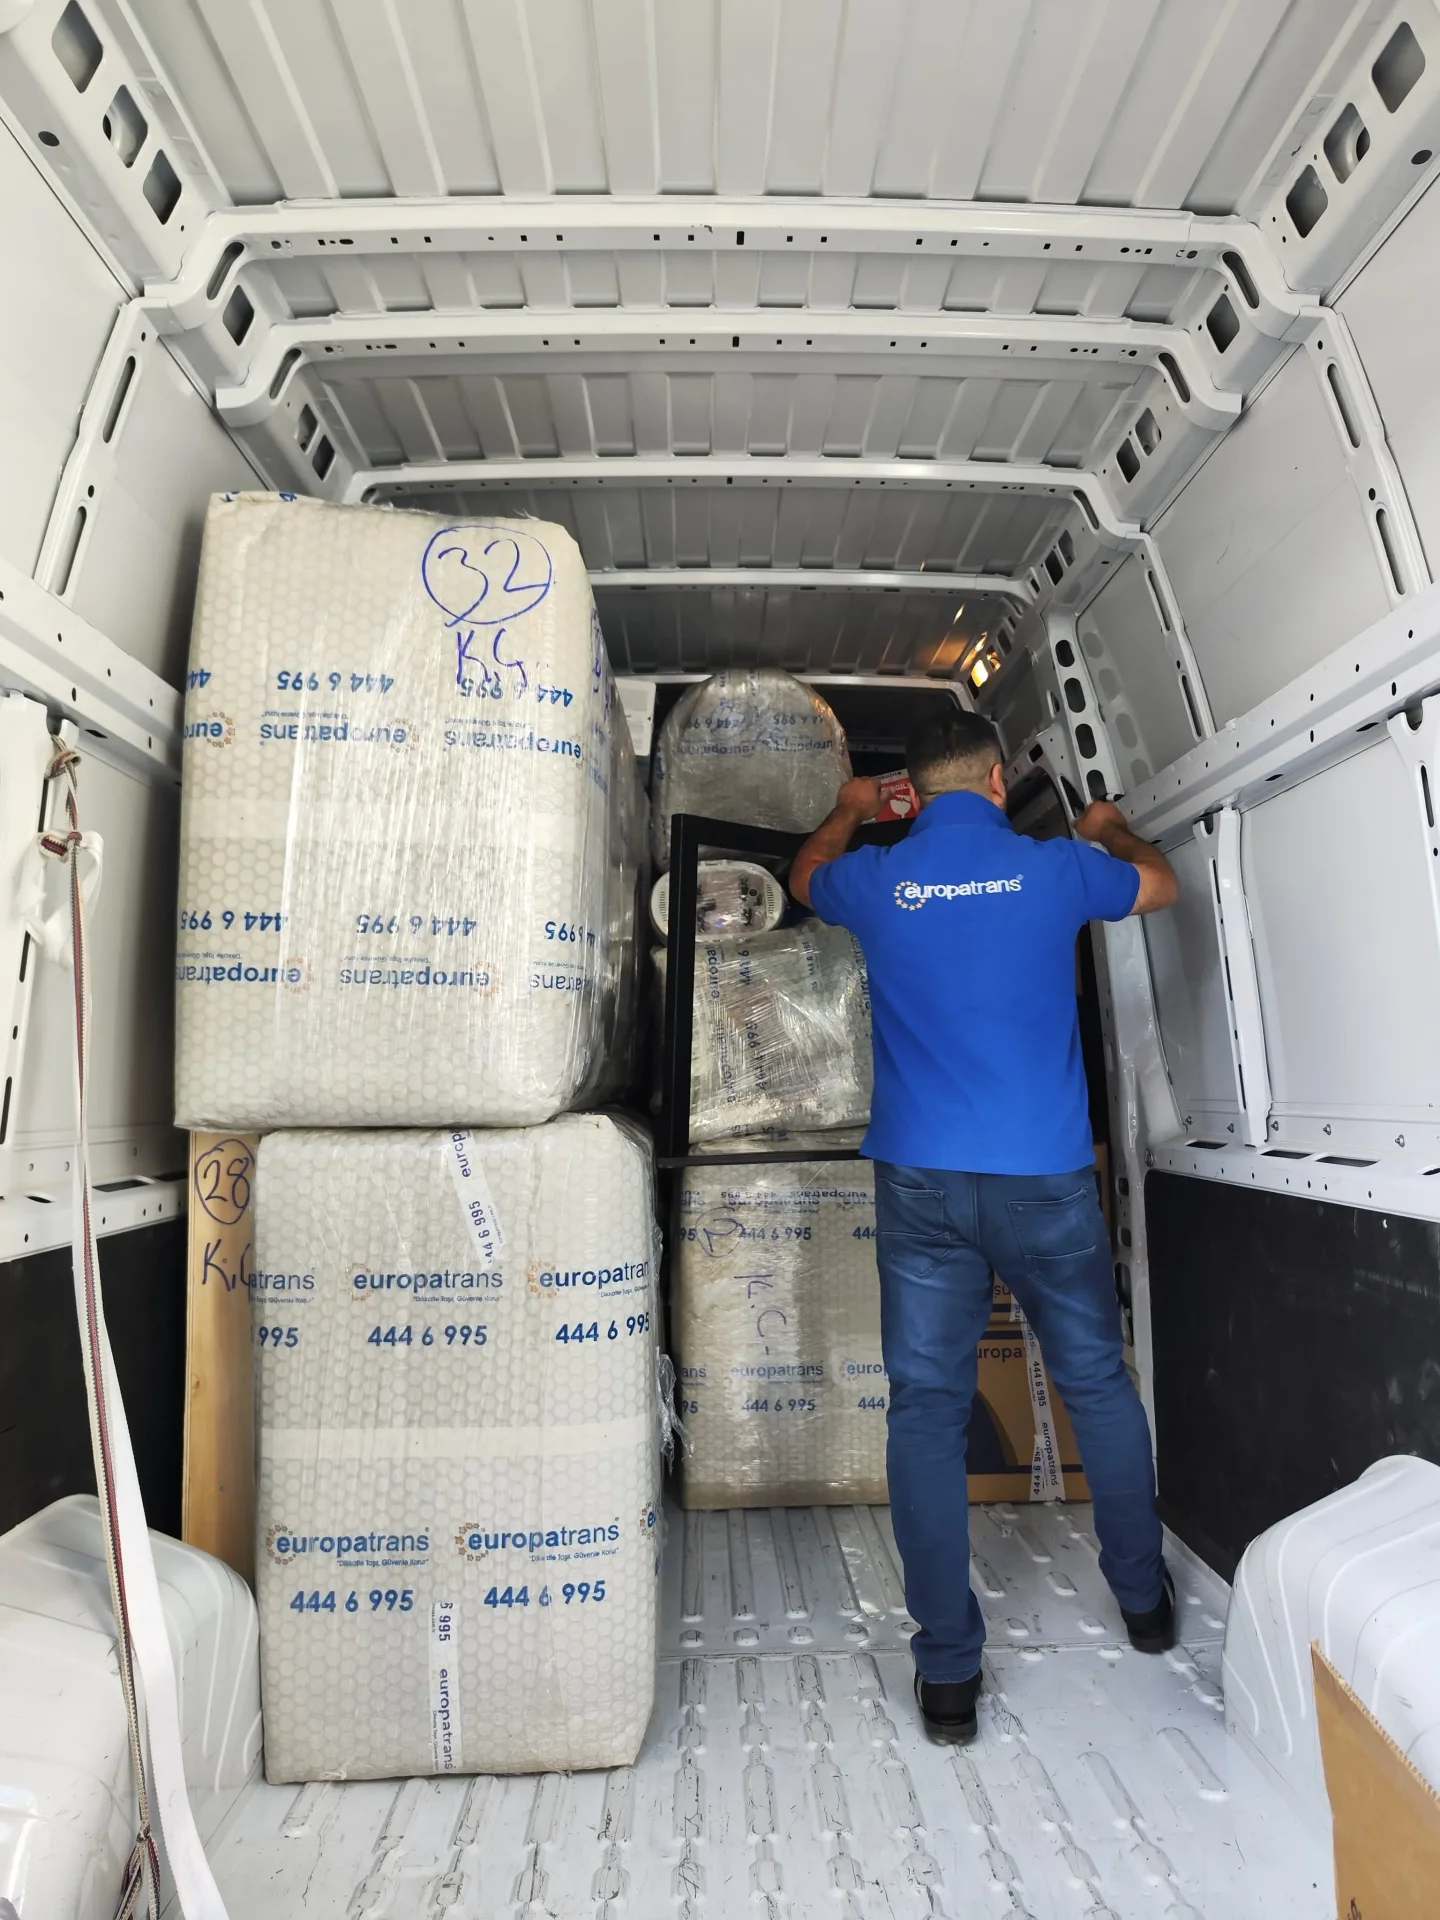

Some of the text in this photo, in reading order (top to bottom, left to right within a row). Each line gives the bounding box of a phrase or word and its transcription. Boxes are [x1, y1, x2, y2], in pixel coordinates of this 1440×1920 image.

[438, 538, 549, 627] 32
[277, 671, 394, 694] 444 6 995
[460, 678, 503, 700] 995
[538, 685, 573, 708] 444
[260, 722, 407, 744] europatrans
[444, 730, 582, 759] europatrans
[904, 879, 1022, 900] europatrans
[180, 911, 213, 930] 995
[222, 910, 235, 930] 6
[356, 913, 476, 937] 444 6 995
[545, 920, 577, 943] 995
[340, 966, 490, 989] europatrans
[203, 1157, 250, 1209] 28
[468, 1200, 486, 1226] 995
[478, 1230, 490, 1239] 6
[784, 1226, 812, 1241] 995
[354, 1269, 503, 1293] europatrans
[259, 1325, 299, 1348] 995
[368, 1324, 488, 1347] 444 6 995
[555, 1311, 650, 1344] 444 6 995
[730, 1362, 824, 1379] europatrans
[847, 1364, 886, 1377] euro
[1032, 1360, 1043, 1379] 444
[742, 1398, 816, 1413] 444 6 995
[858, 1396, 886, 1410] 444
[1036, 1389, 1047, 1407] 995
[1041, 1422, 1060, 1486] europatrans
[1033, 1463, 1042, 1471] 6
[1032, 1474, 1041, 1495] 444
[276, 1531, 430, 1558] europatrans
[468, 1524, 620, 1553] europatrans
[290, 1589, 414, 1613] 444 6 995
[483, 1579, 606, 1609] 444 6 995
[438, 1615, 452, 1642] 995
[438, 1668, 455, 1770] europatrans
